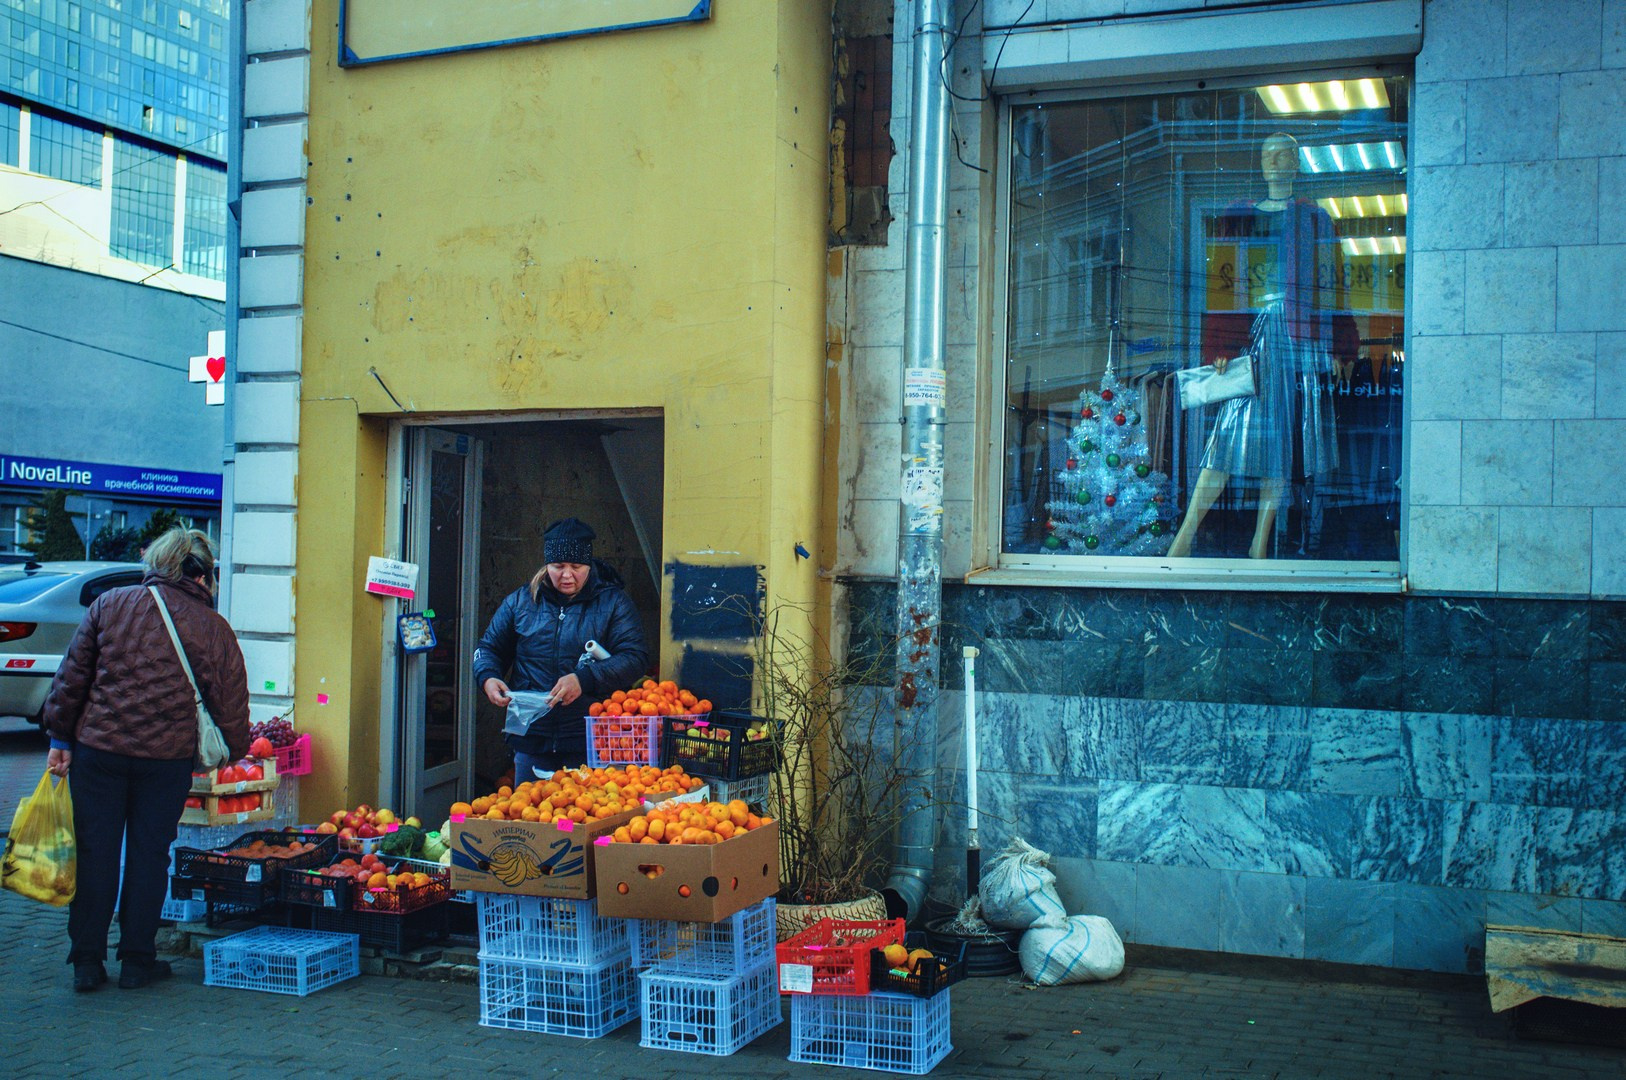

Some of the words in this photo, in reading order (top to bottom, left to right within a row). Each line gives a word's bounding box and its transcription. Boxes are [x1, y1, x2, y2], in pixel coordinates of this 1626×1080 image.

[10, 461, 92, 485] NovaLine
[141, 472, 178, 483] клиника
[104, 480, 154, 491] врачебной
[155, 483, 214, 495] косметологии
[492, 827, 536, 840] ИМПЕРИАЛ
